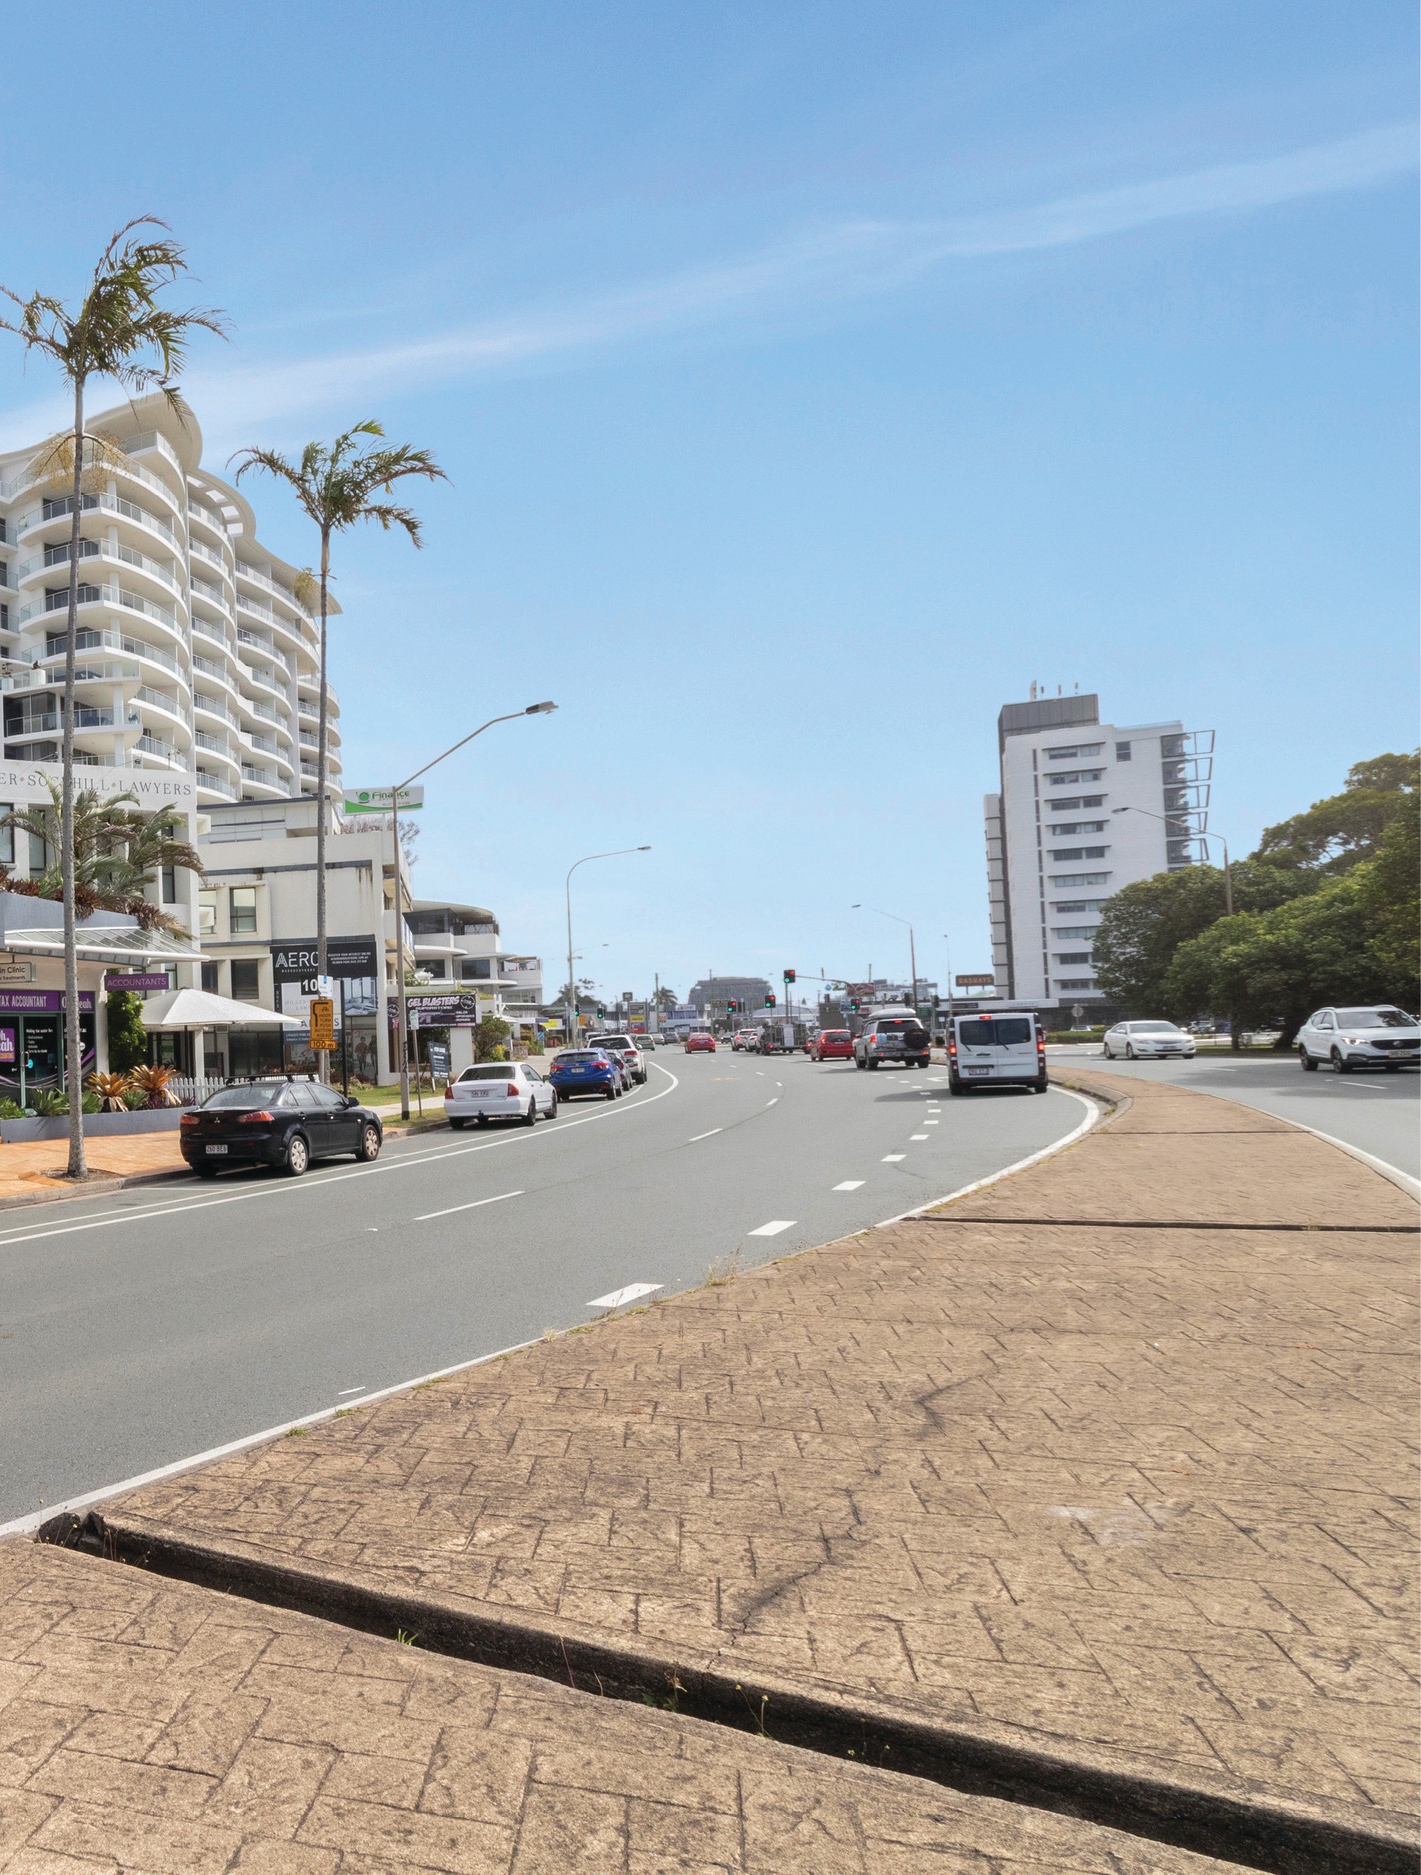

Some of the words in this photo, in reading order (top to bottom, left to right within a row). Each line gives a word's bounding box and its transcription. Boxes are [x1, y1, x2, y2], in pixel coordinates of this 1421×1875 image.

[28, 774, 110, 790] SOCHILL
[119, 780, 192, 796] LAWYERS
[107, 978, 166, 986] ACCOUNTANTS
[12, 996, 47, 1008] ACCOUNTANT
[407, 998, 421, 1007] GEL
[422, 996, 460, 1006] BLASTERS
